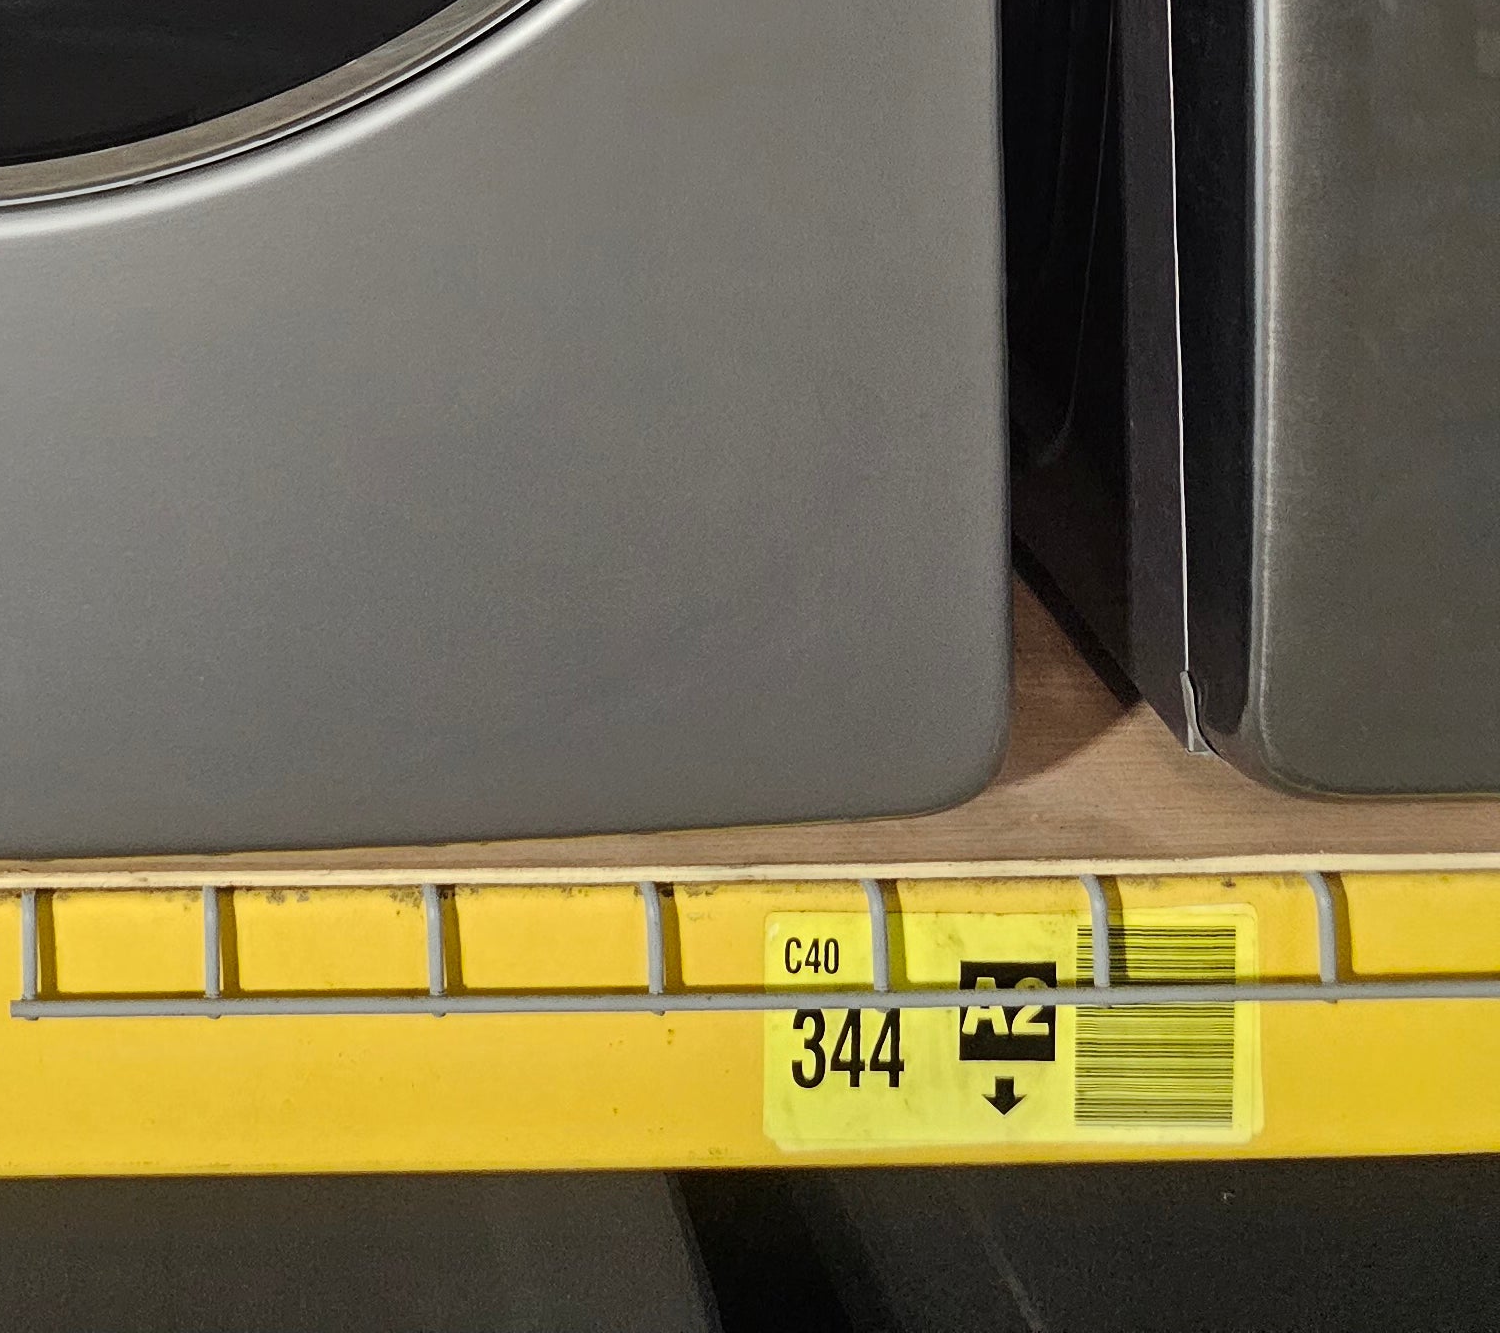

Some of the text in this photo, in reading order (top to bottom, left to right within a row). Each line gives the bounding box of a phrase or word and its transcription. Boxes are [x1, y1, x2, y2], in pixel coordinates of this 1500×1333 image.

[785, 937, 839, 974] C40
[962, 977, 1049, 1036] A2
[791, 1007, 905, 1089] 344
